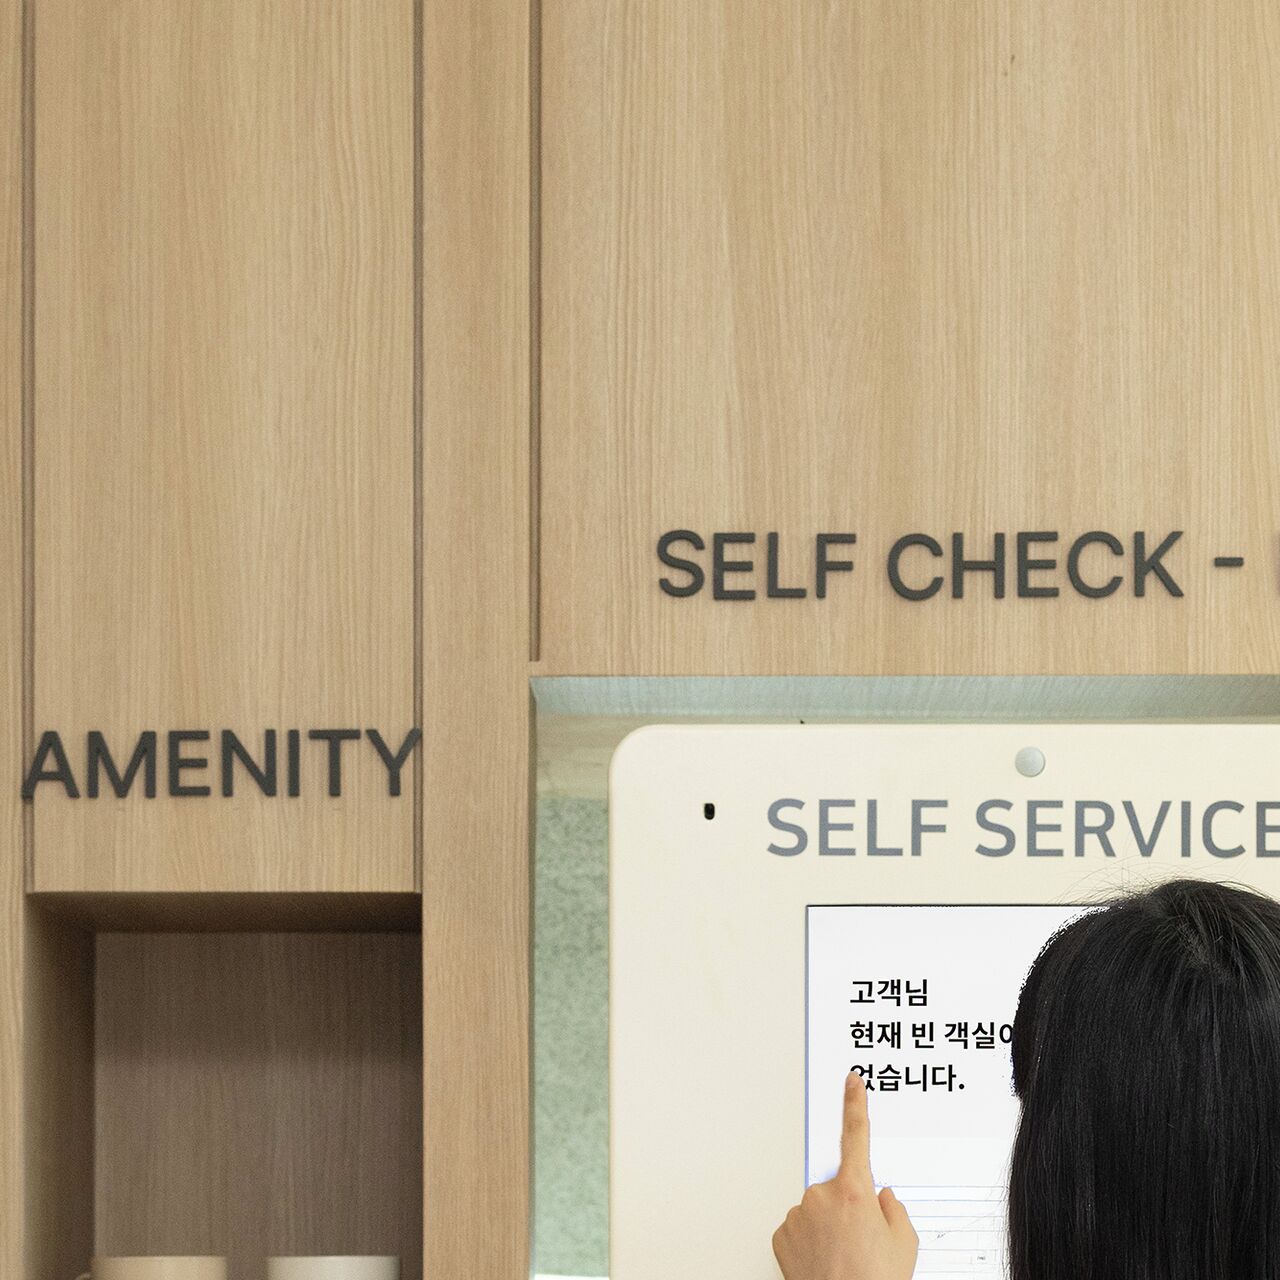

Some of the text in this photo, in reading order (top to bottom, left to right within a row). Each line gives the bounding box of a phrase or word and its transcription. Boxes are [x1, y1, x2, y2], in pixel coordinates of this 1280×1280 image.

[657, 530, 857, 602] SELF
[886, 530, 1185, 602] CHECK
[23, 726, 424, 800] AMENITY
[767, 798, 948, 858] SELF
[849, 978, 928, 1007] 고객님
[849, 1020, 901, 1050] 현재
[911, 1021, 935, 1050] 빈
